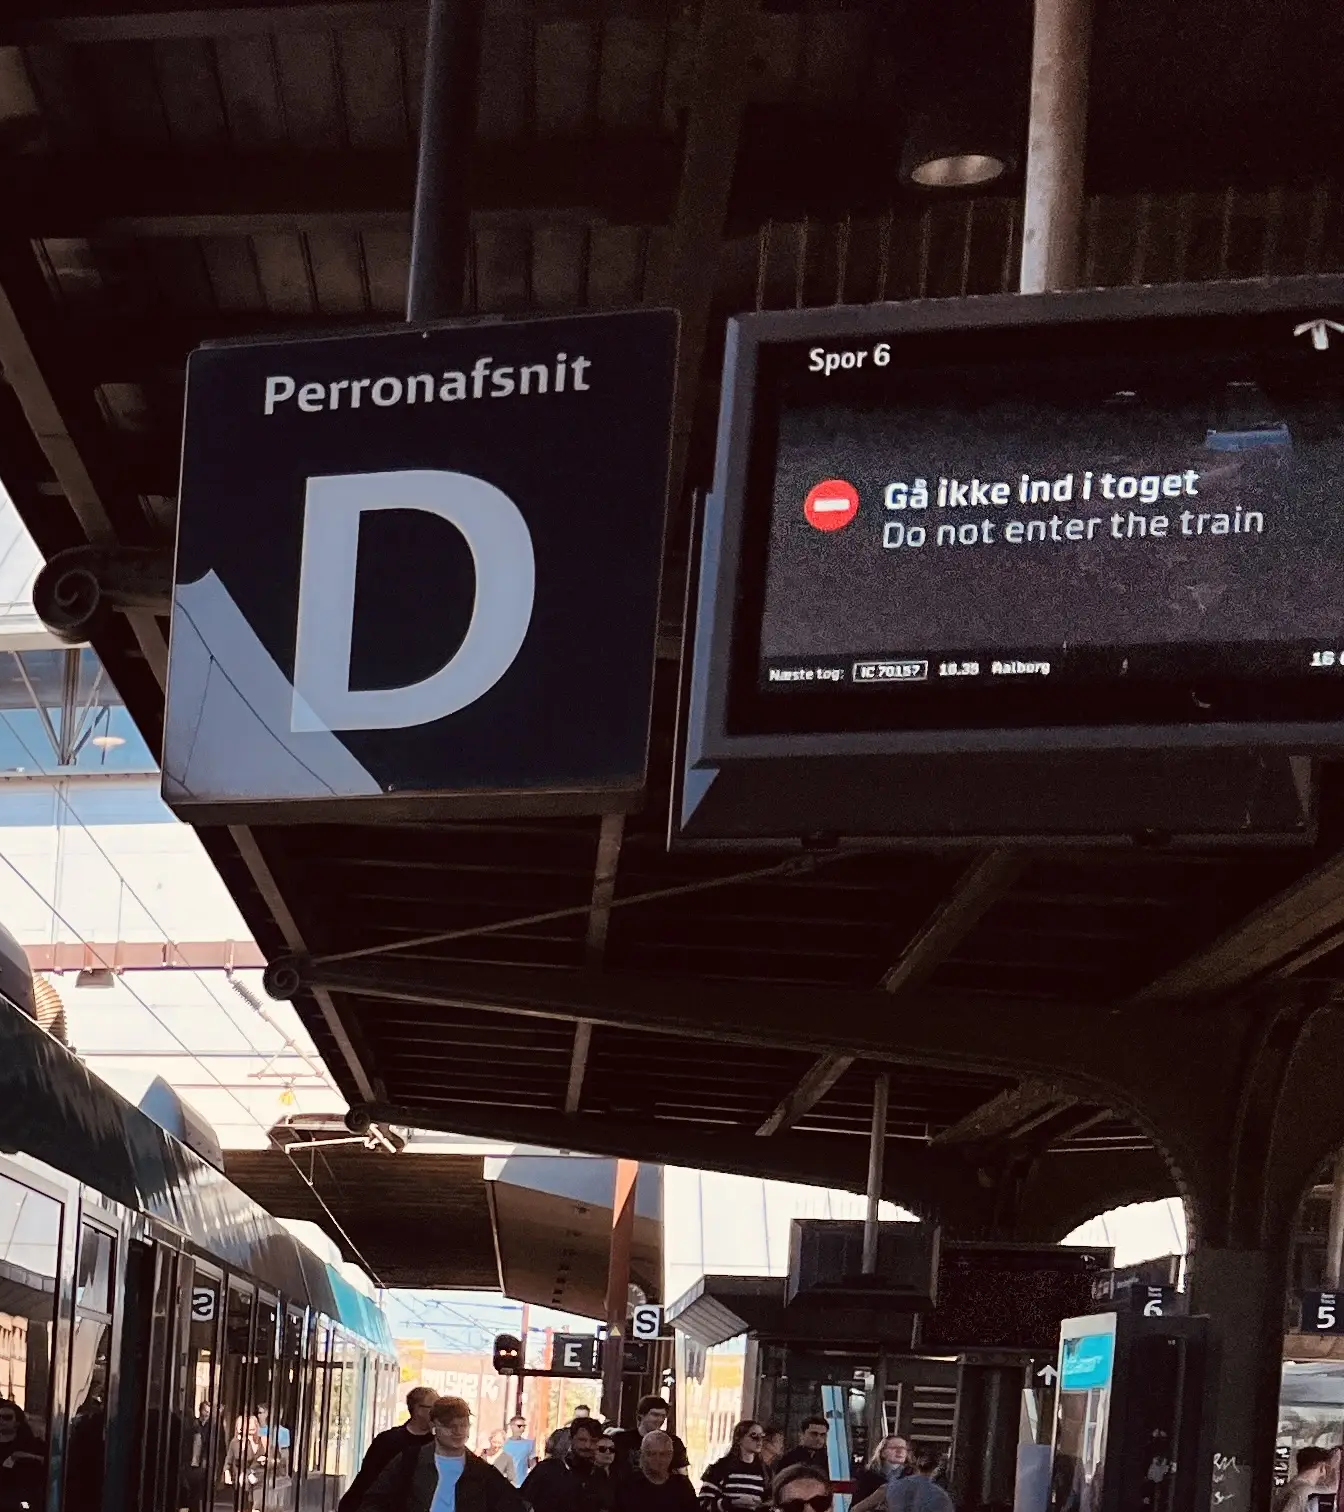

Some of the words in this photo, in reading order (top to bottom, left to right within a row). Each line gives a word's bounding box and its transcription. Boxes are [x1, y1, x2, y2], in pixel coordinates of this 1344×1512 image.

[809, 347, 868, 377] Spor
[873, 343, 891, 366] 6
[264, 352, 593, 416] Perronafsnit
[884, 478, 929, 510] Gå
[936, 477, 1011, 508] ikke
[1018, 473, 1074, 504] ind
[1082, 471, 1093, 502] i
[1099, 469, 1200, 505] toget
[882, 522, 927, 549] Do
[936, 517, 996, 547] not
[1004, 515, 1102, 544] enter
[1111, 511, 1169, 539] the
[1179, 505, 1264, 535] train
[290, 469, 536, 734] D
[769, 669, 814, 681] Næste
[861, 665, 876, 678] IC
[991, 660, 1051, 676] Aalborg
[635, 1310, 657, 1334] S
[1316, 1306, 1336, 1329] 5
[564, 1343, 582, 1367] E
